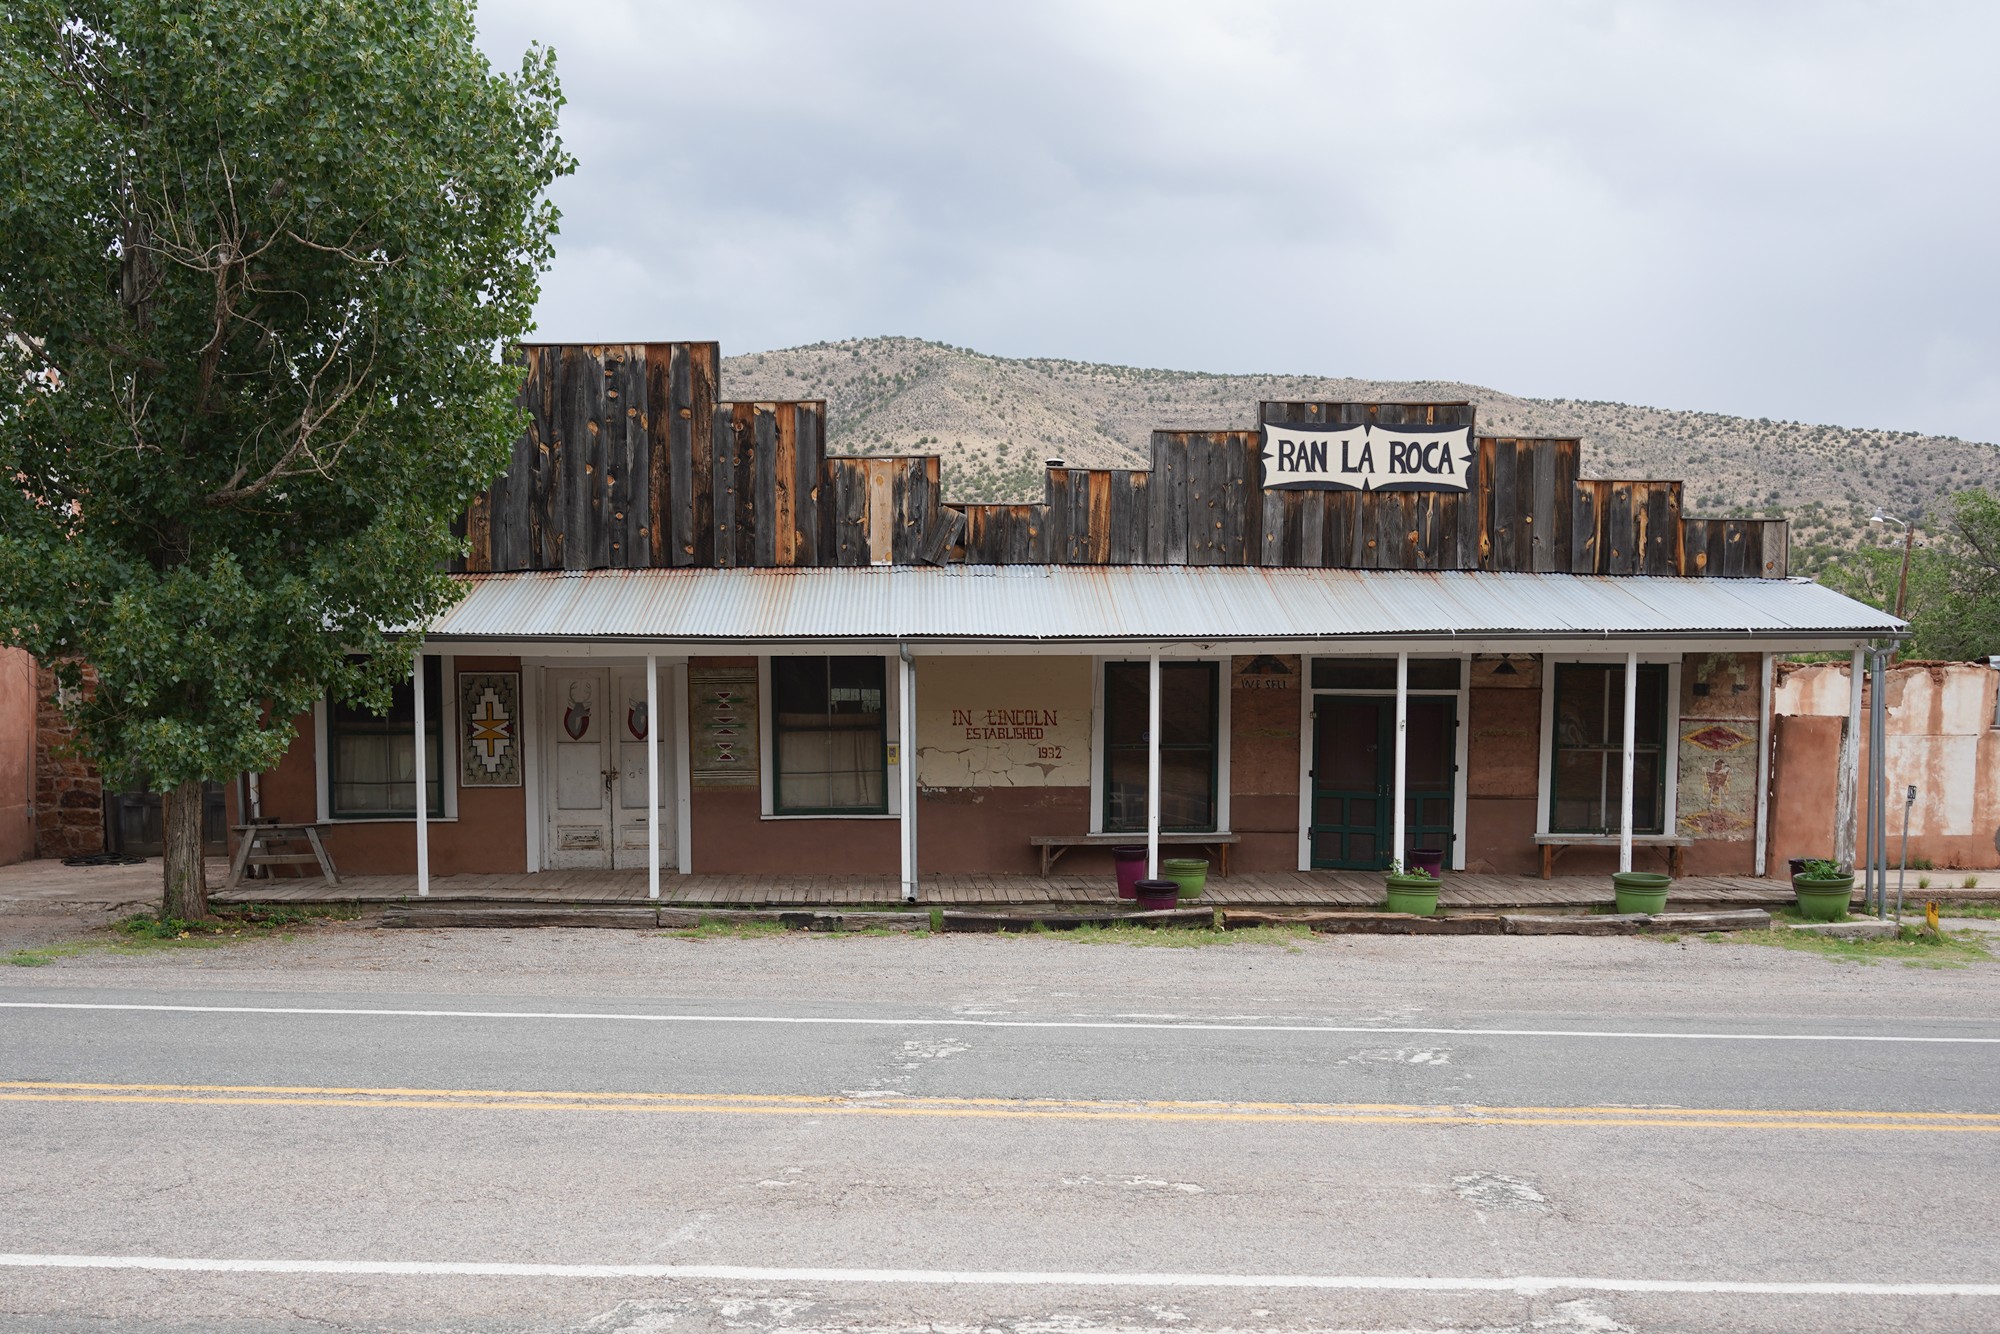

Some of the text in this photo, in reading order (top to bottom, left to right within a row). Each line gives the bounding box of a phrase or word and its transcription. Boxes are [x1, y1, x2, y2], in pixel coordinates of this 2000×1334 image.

[1277, 439, 1456, 475] RAN LA ROCA
[952, 709, 1058, 727] IN LINCOLN
[966, 727, 1044, 740] ESTABLISHED
[1037, 746, 1063, 759] 1932
